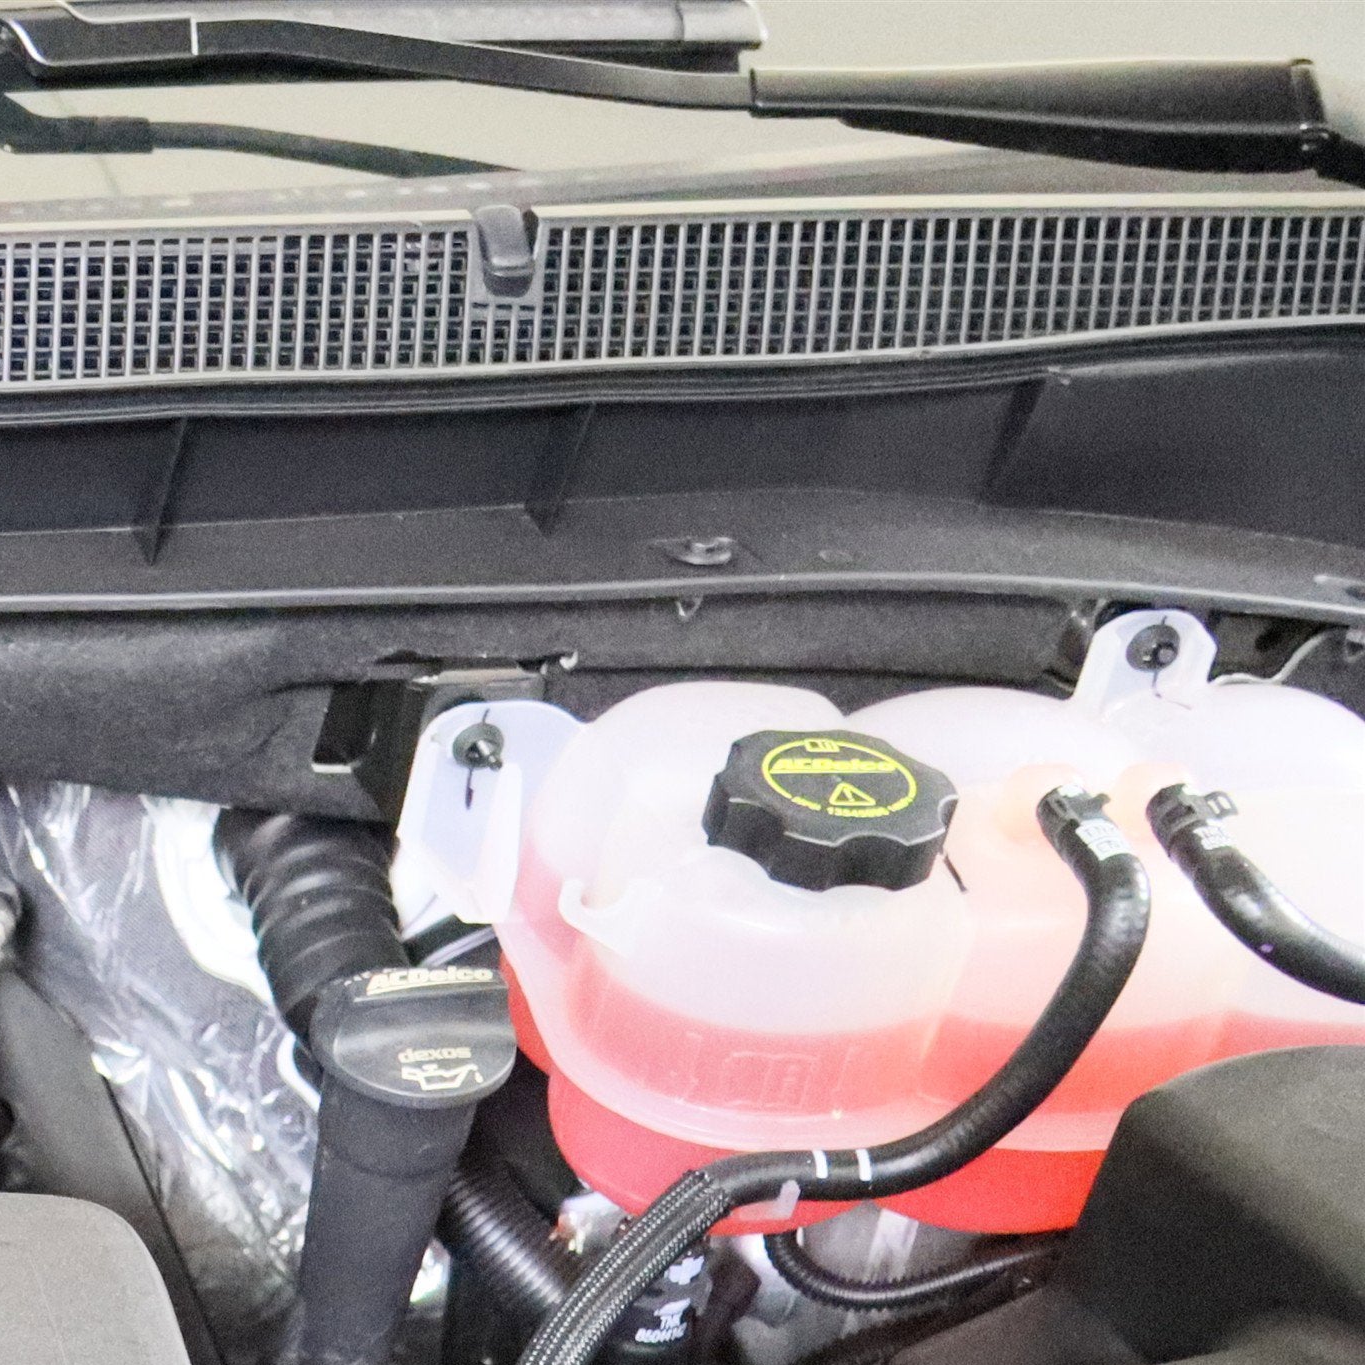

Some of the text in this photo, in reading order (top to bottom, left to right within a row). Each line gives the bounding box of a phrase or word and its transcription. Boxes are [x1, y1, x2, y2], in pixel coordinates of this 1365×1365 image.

[770, 757, 897, 773] ACDelco
[366, 965, 494, 994] ACDelco
[398, 1048, 472, 1063] dexos
